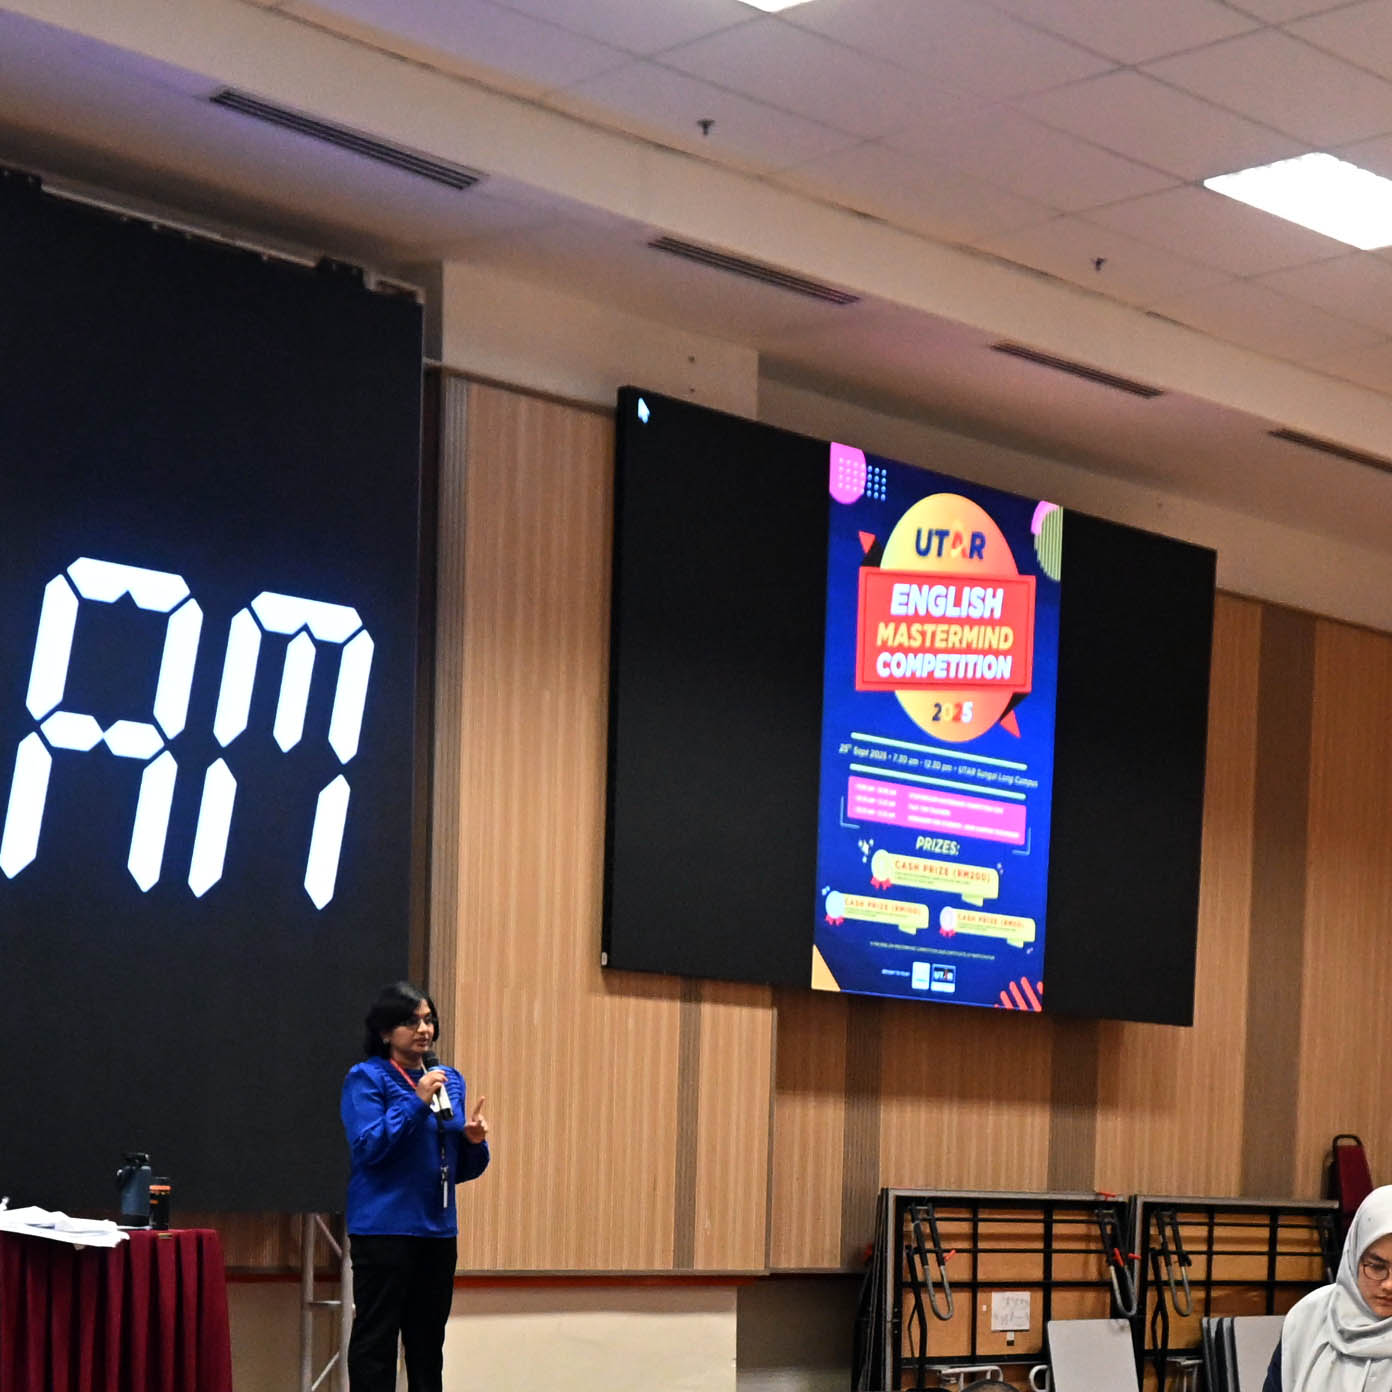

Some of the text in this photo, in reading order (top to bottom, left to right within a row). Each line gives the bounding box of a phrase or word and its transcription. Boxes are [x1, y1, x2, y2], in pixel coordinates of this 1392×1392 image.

[915, 524, 987, 560] UTAR
[890, 583, 1004, 619] ENGLISH
[876, 622, 1014, 650] MASTERMIND
[876, 652, 1013, 680] COMPETITION
[932, 701, 974, 723] 2025
[0, 557, 375, 909] AM
[958, 765, 977, 777] UTAR
[976, 767, 998, 781] Sungai
[998, 773, 1014, 785] Long
[1015, 775, 1038, 789] Campus
[916, 836, 961, 856] PRIZES:
[895, 860, 920, 871] CASH
[923, 862, 949, 876] PRIZE
